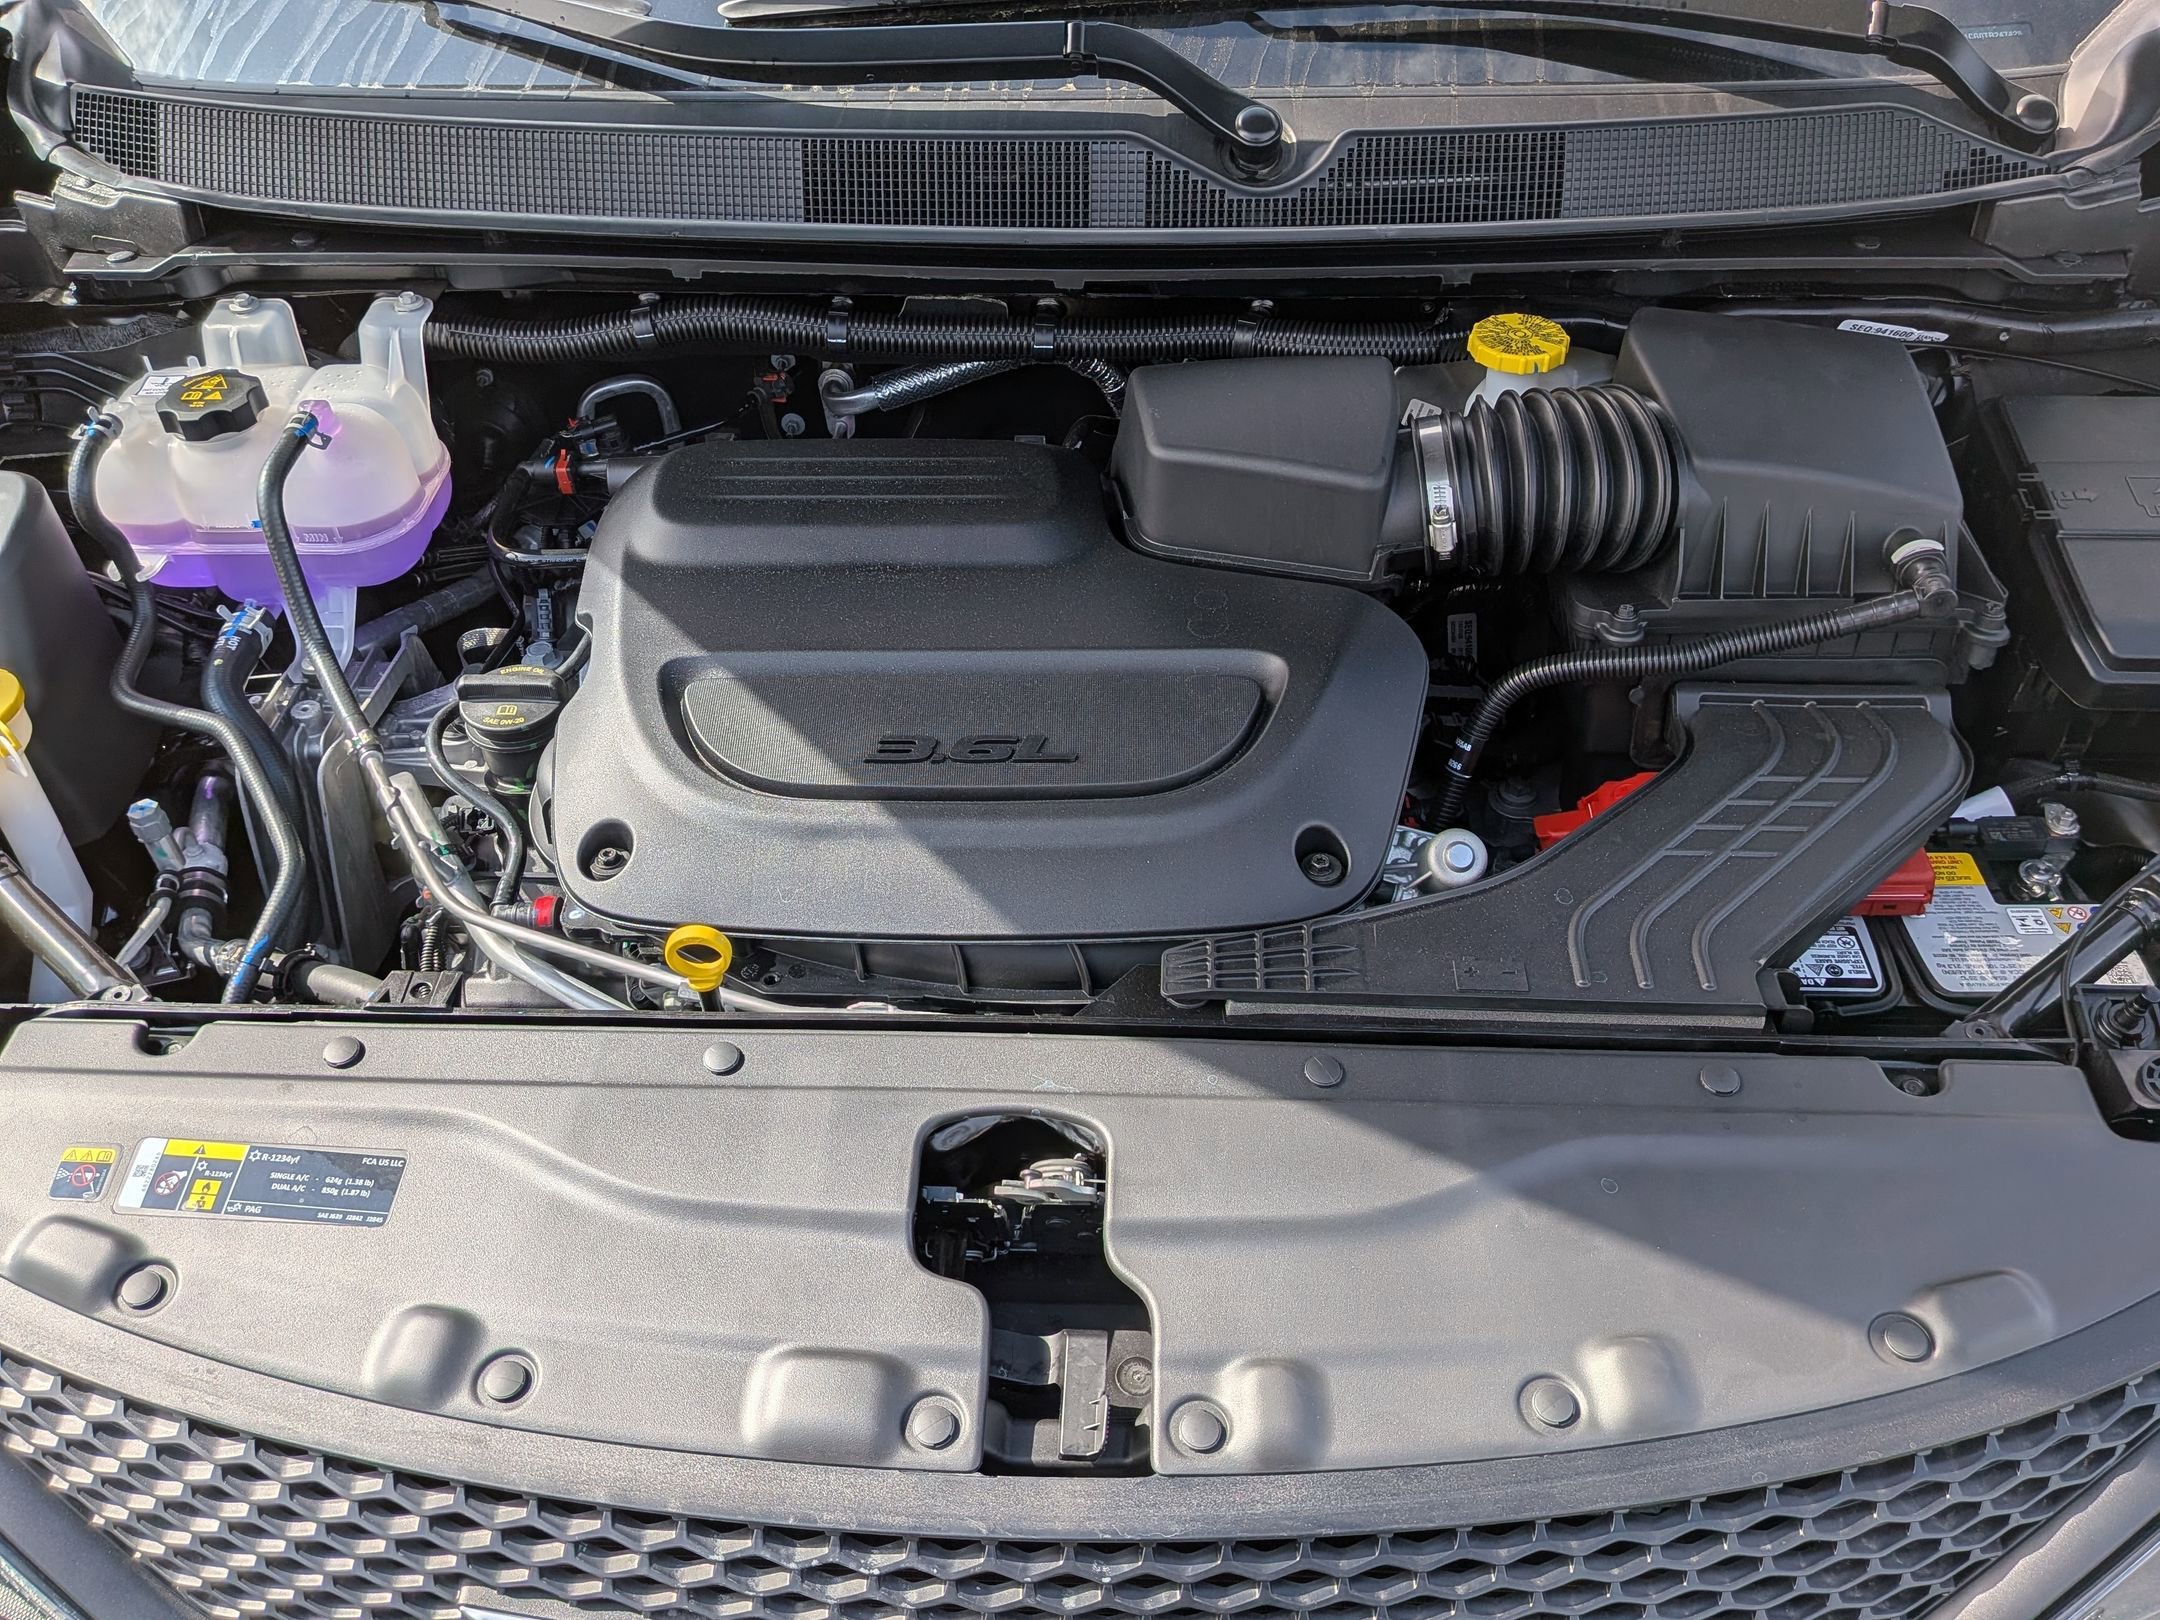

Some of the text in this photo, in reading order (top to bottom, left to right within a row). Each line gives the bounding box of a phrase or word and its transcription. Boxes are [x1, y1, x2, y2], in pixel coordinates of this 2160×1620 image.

[500, 666, 545, 675] ENGINE OIL
[483, 716, 499, 725] SAE
[863, 735, 1079, 763] 3.6L
[261, 1153, 301, 1165] R-1234yf
[362, 1157, 405, 1168] FCA US LLC
[270, 1171, 295, 1181] SINGLE
[296, 1173, 311, 1182] A/C
[325, 1177, 343, 1186] 624g
[345, 1177, 364, 1187] (1.38
[364, 1179, 375, 1188] lb)
[271, 1182, 291, 1191] DUAL
[292, 1184, 307, 1193] A/C
[321, 1187, 339, 1196] 850g
[360, 1189, 371, 1199] lb)
[244, 1205, 262, 1214] PAG
